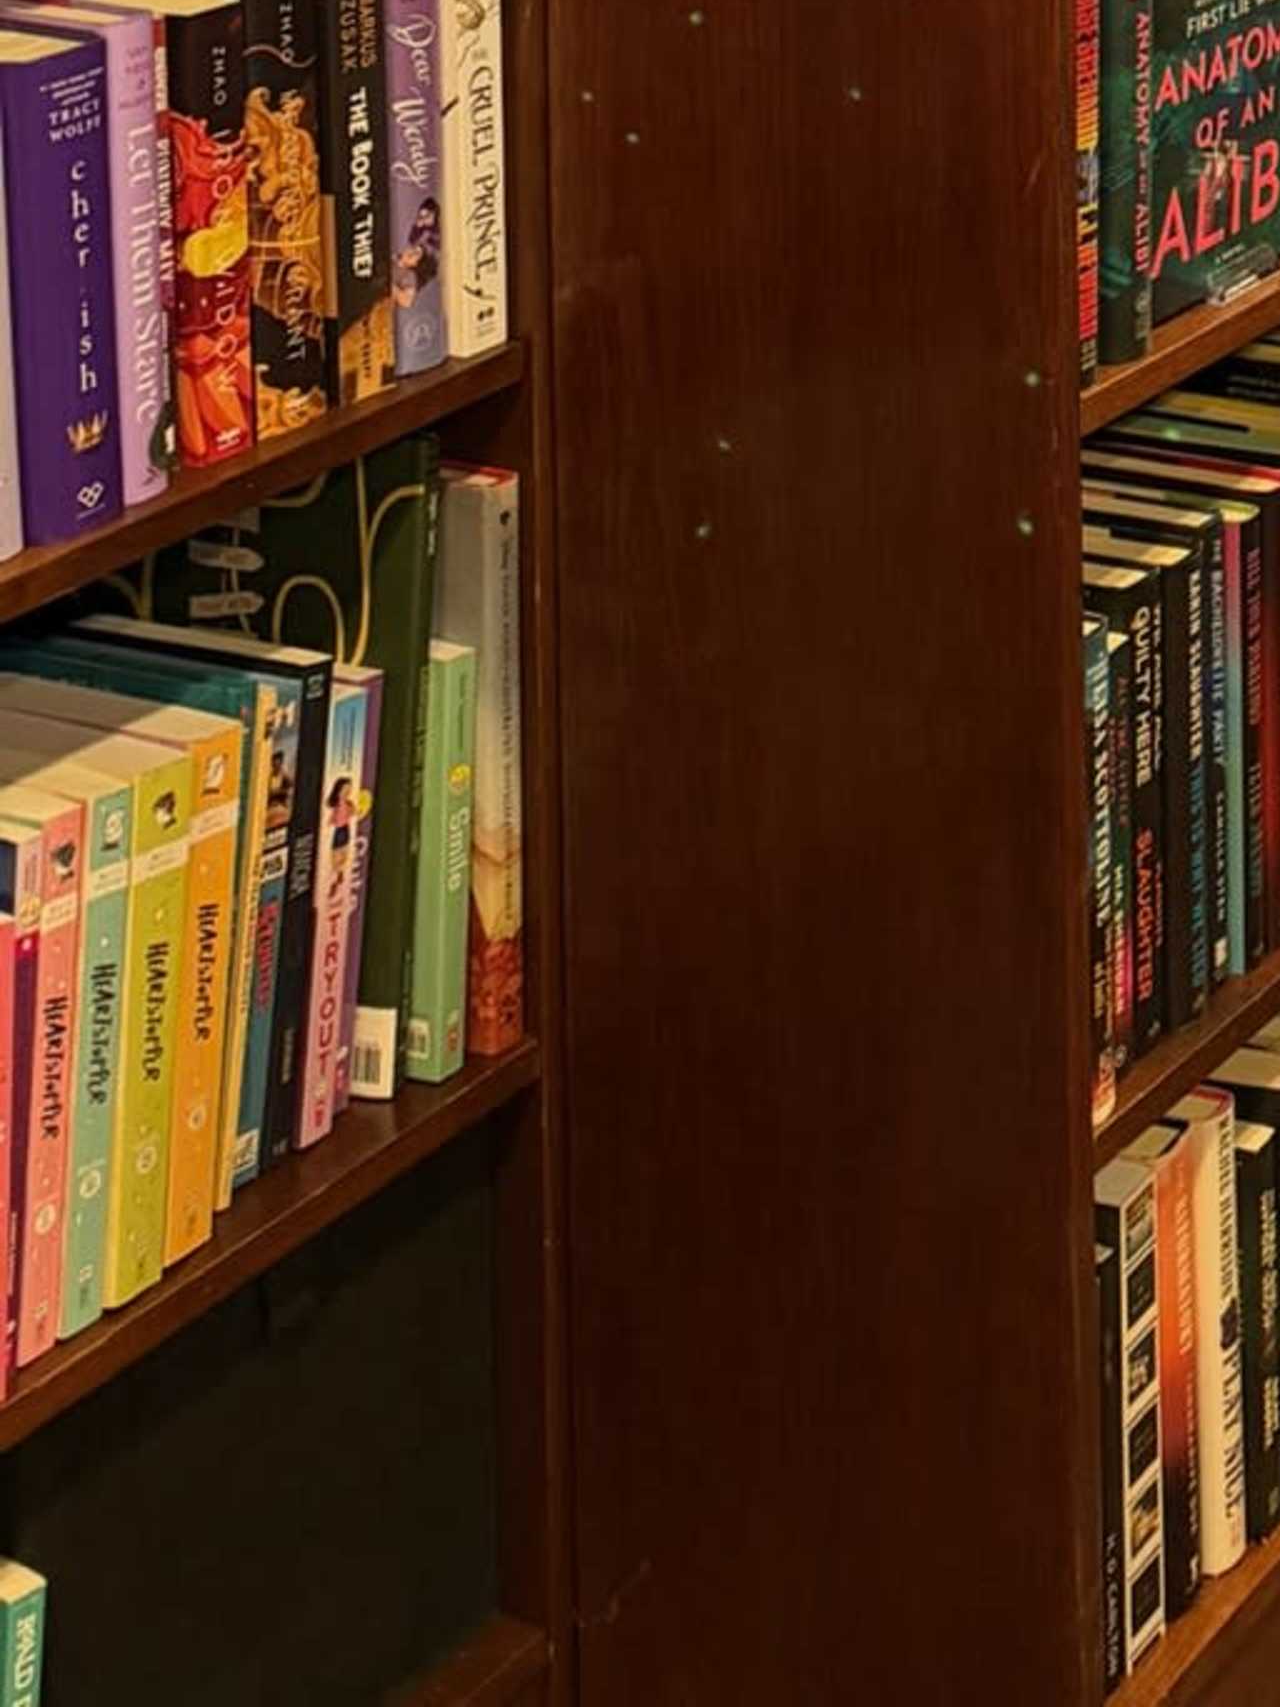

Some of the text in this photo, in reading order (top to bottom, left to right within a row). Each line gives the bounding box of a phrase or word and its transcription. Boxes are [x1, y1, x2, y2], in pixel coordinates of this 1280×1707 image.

[211, 44, 227, 107] ZHAO
[279, 1, 296, 62] ZHAO
[1134, 12, 1150, 145] ANATOMY
[1186, 5, 1225, 38] FIRST
[347, 86, 376, 280] THE BOOK THIEF
[391, 87, 437, 188] Wendy
[469, 65, 500, 283] CRUEL PRINCE
[1195, 85, 1276, 148] OF AN
[129, 180, 158, 306] Them
[134, 312, 161, 428] Stare
[1131, 605, 1153, 788] GUILTY HERE
[445, 806, 471, 891] Smile
[1093, 755, 1112, 930] SCOTTOLINE
[195, 901, 220, 1043] HEARTSTOPPER
[1136, 827, 1155, 1003] SLAUGHTER
[43, 995, 71, 1139] HEARTSTOPPER
[89, 961, 118, 1105] HEARTSTOPPER
[146, 939, 171, 1083] HEARTSTOPPER
[1222, 1345, 1243, 1435] PLAY
